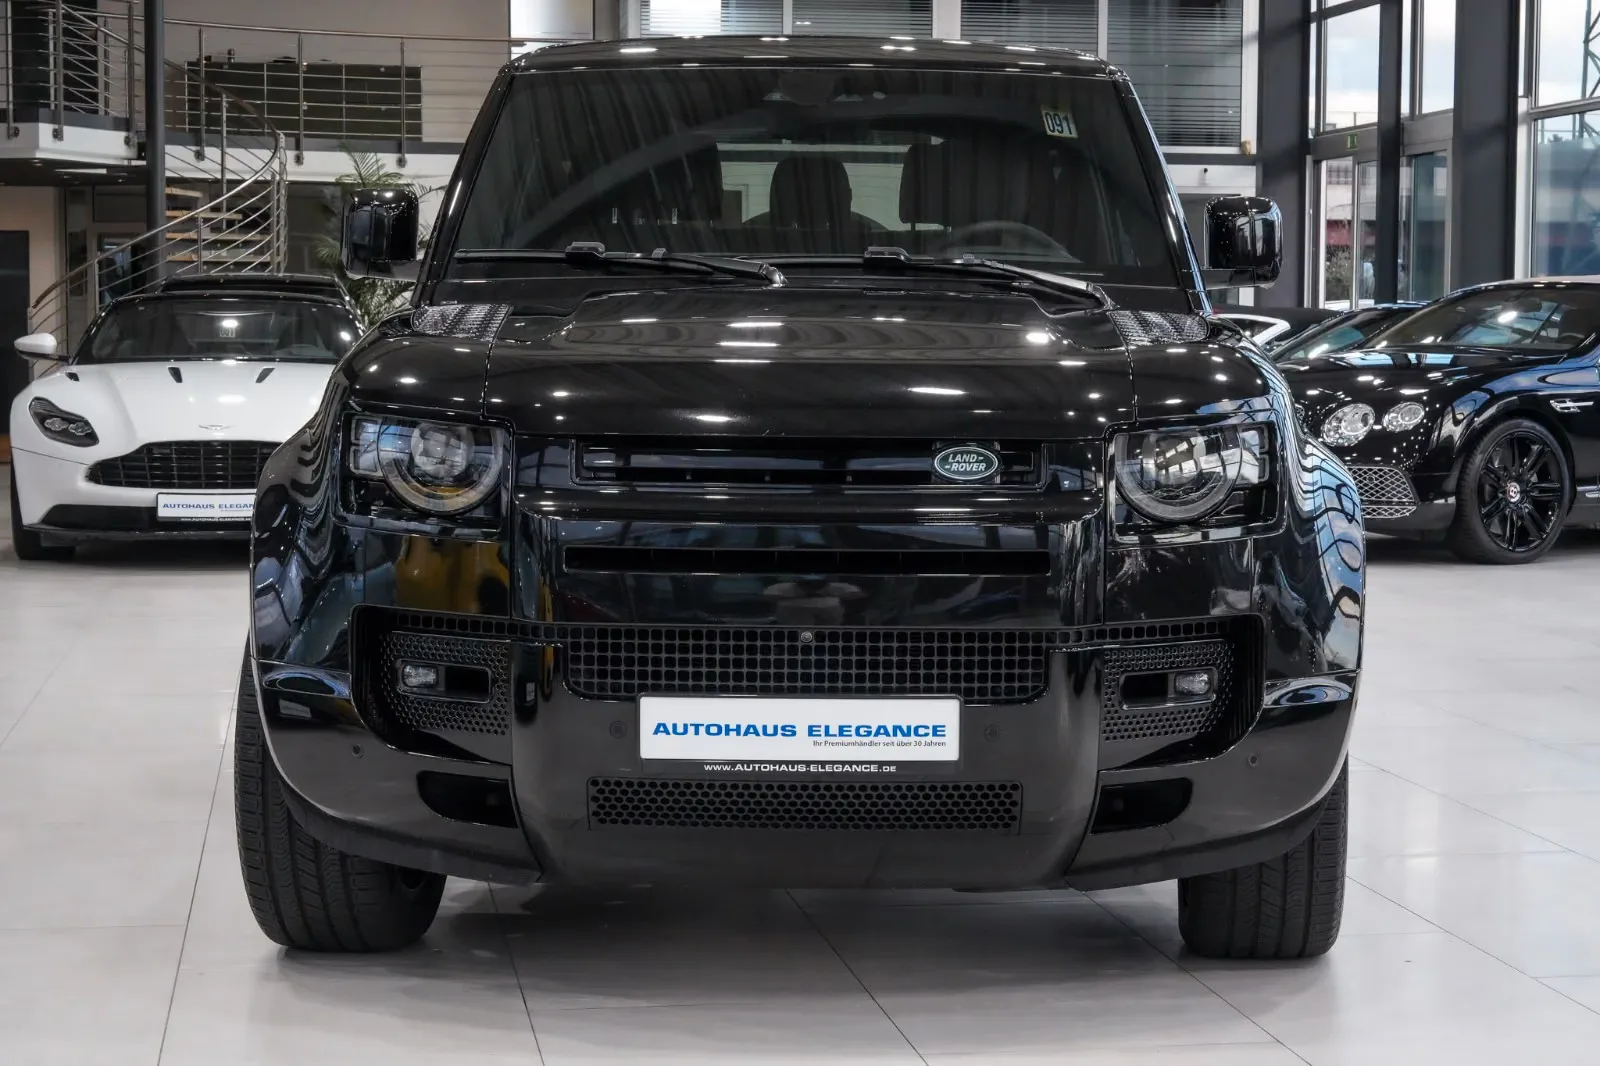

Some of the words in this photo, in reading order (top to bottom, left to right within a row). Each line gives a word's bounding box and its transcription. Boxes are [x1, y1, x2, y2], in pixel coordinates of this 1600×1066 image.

[1044, 111, 1073, 136] 091
[652, 722, 798, 738] AUTOHAUS
[807, 724, 947, 738] ELEGANCE
[897, 739, 911, 747] über
